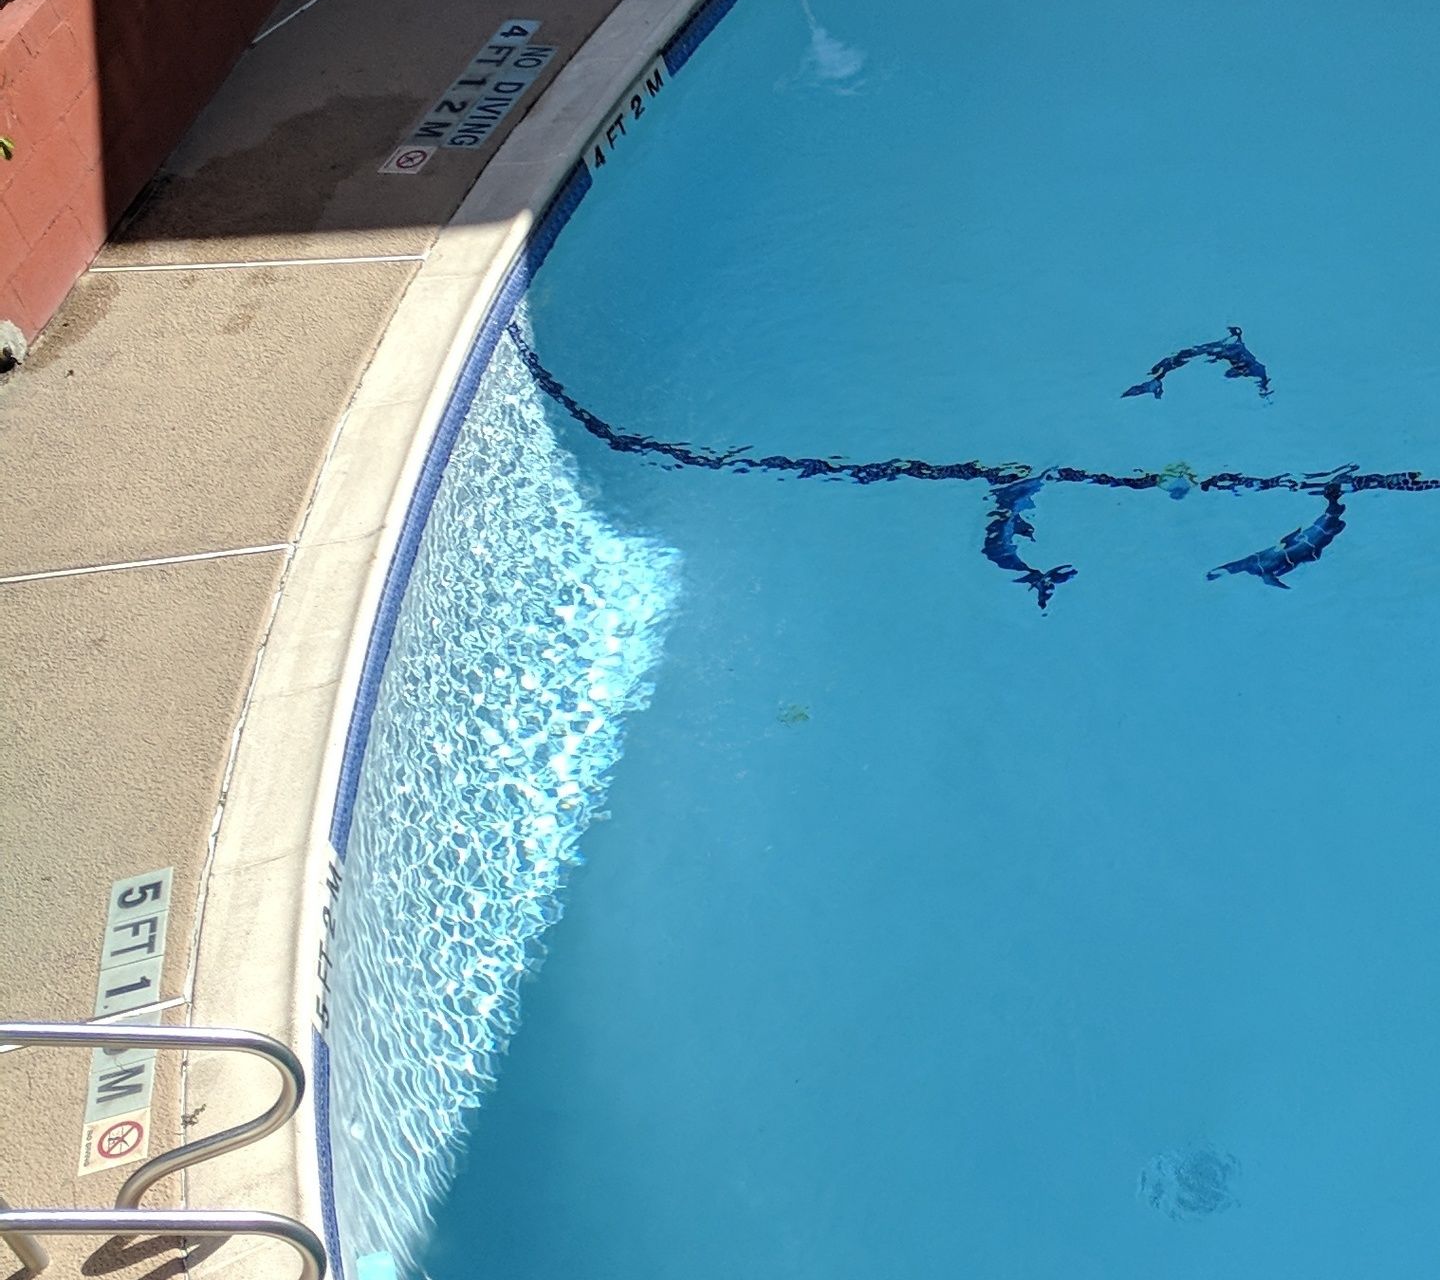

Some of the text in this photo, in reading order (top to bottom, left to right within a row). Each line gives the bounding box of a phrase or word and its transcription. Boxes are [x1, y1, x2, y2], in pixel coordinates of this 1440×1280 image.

[500, 24, 529, 38] 4
[476, 44, 514, 67] FT
[448, 46, 553, 148] NO DIVING
[595, 67, 664, 169] 4 FT 2 M
[415, 120, 451, 139] M
[117, 879, 164, 909] 5
[110, 915, 159, 958] FT
[316, 860, 343, 1030] 5 FT 2 M
[96, 1063, 146, 1105] M
